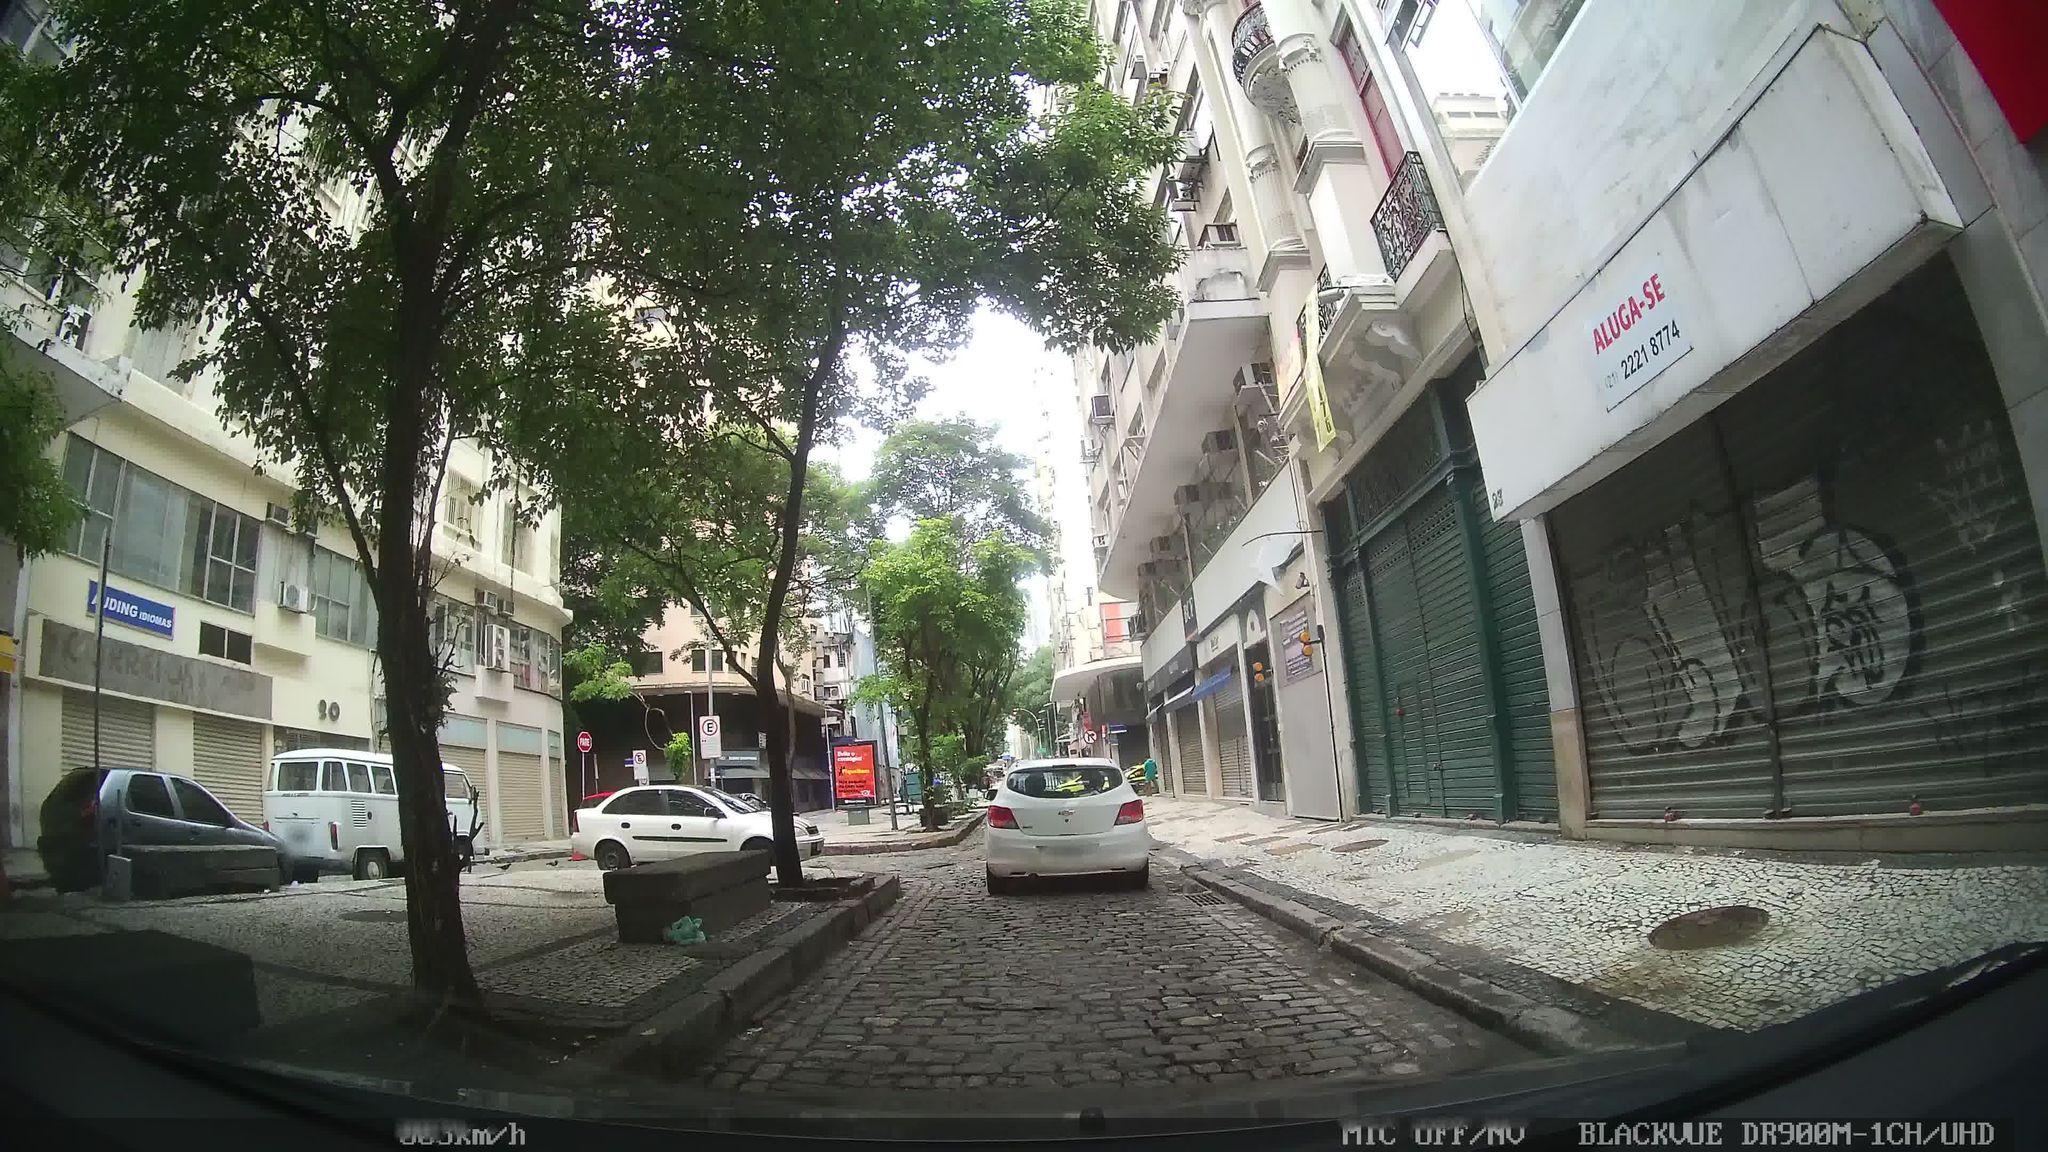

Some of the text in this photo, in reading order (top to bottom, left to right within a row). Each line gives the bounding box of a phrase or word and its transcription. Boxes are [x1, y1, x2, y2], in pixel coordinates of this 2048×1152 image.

[1593, 273, 1665, 354] ALUGA-SE
[1621, 344, 1649, 379] 2221
[1650, 319, 1681, 357] 8774
[139, 611, 172, 629] IDIOMAS
